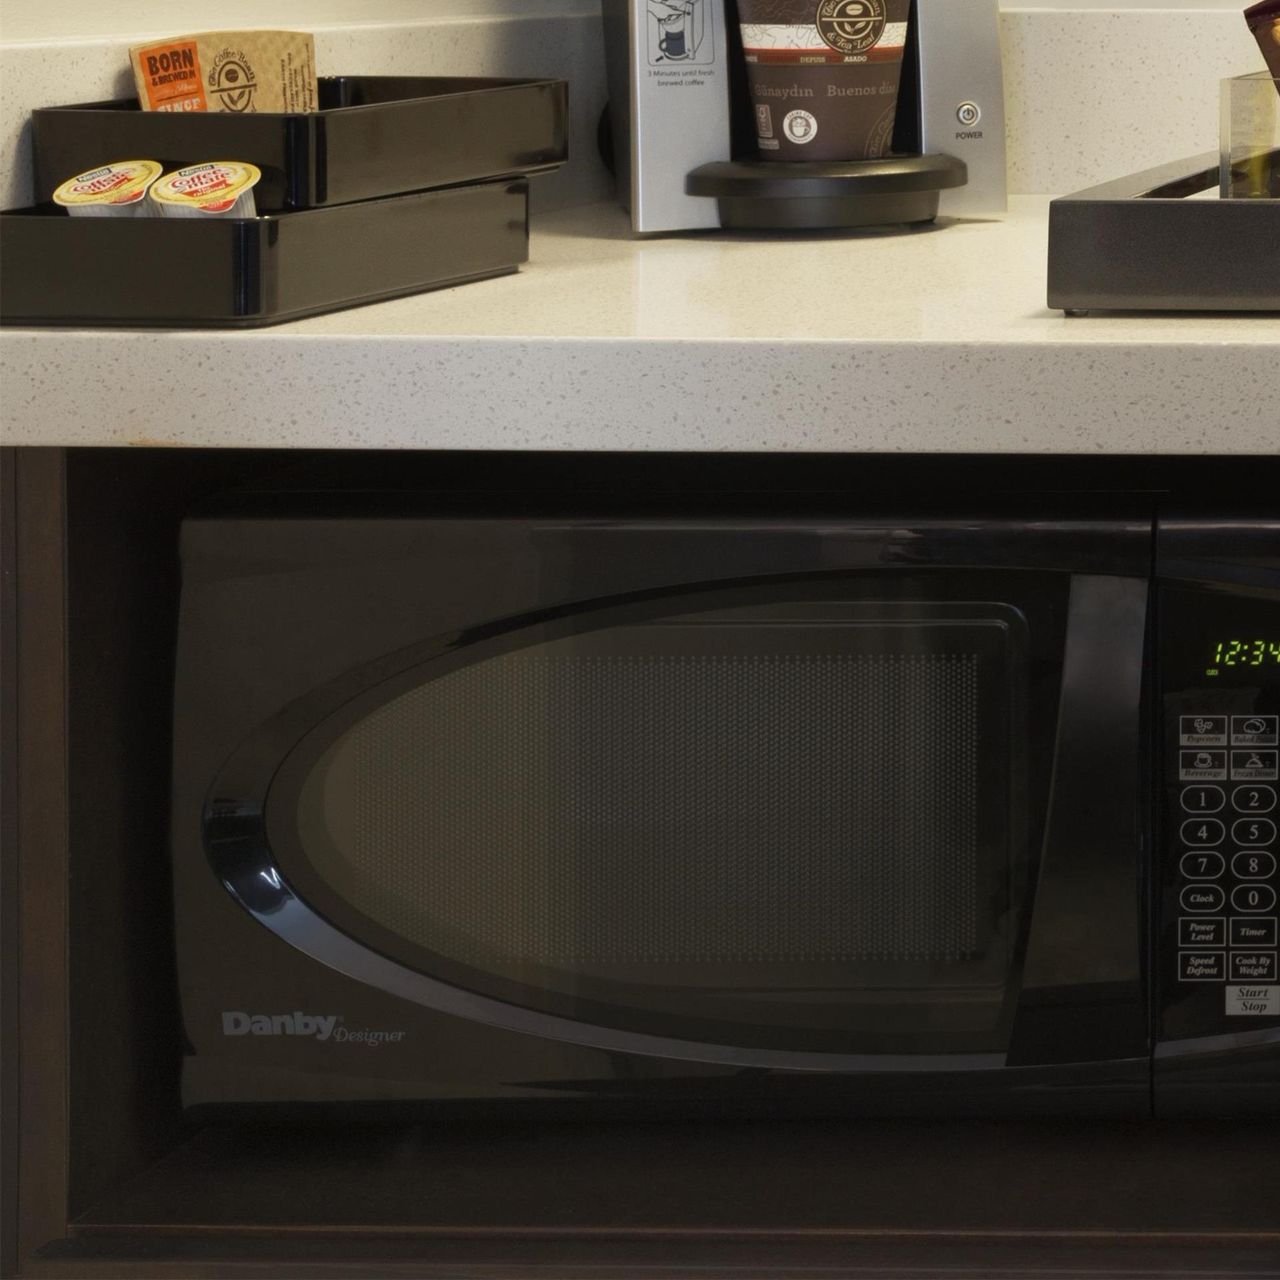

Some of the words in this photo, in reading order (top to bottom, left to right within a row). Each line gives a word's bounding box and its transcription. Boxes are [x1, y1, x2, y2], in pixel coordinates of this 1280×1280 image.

[827, 32, 837, 42] &
[837, 36, 853, 49] Tea
[857, 31, 875, 48] Leaf
[147, 48, 194, 77] BORN
[152, 77, 158, 87] &
[159, 71, 188, 86] BREWED
[698, 69, 715, 77] fresh
[827, 85, 877, 97] Buenos
[955, 131, 983, 140] POWER
[1199, 792, 1207, 808] 1
[1249, 792, 1259, 808] 2
[1198, 825, 1208, 840] 4
[1249, 825, 1259, 840] 5
[1198, 858, 1208, 873] 7
[1249, 858, 1259, 873] 8
[1190, 894, 1214, 903] Clock
[1248, 890, 1259, 906] 0
[1189, 922, 1216, 932] Power
[1240, 927, 1267, 936] Timer
[1191, 932, 1214, 941] Level
[1189, 956, 1215, 967] Speed
[1235, 956, 1257, 965] Cook
[1259, 956, 1271, 967] By
[1186, 966, 1218, 976] Defrost
[1239, 966, 1268, 976] Weight
[1238, 987, 1269, 998] Start
[1241, 1001, 1267, 1014] Stop
[222, 1011, 337, 1041] Danby
[333, 1026, 406, 1047] Designer
